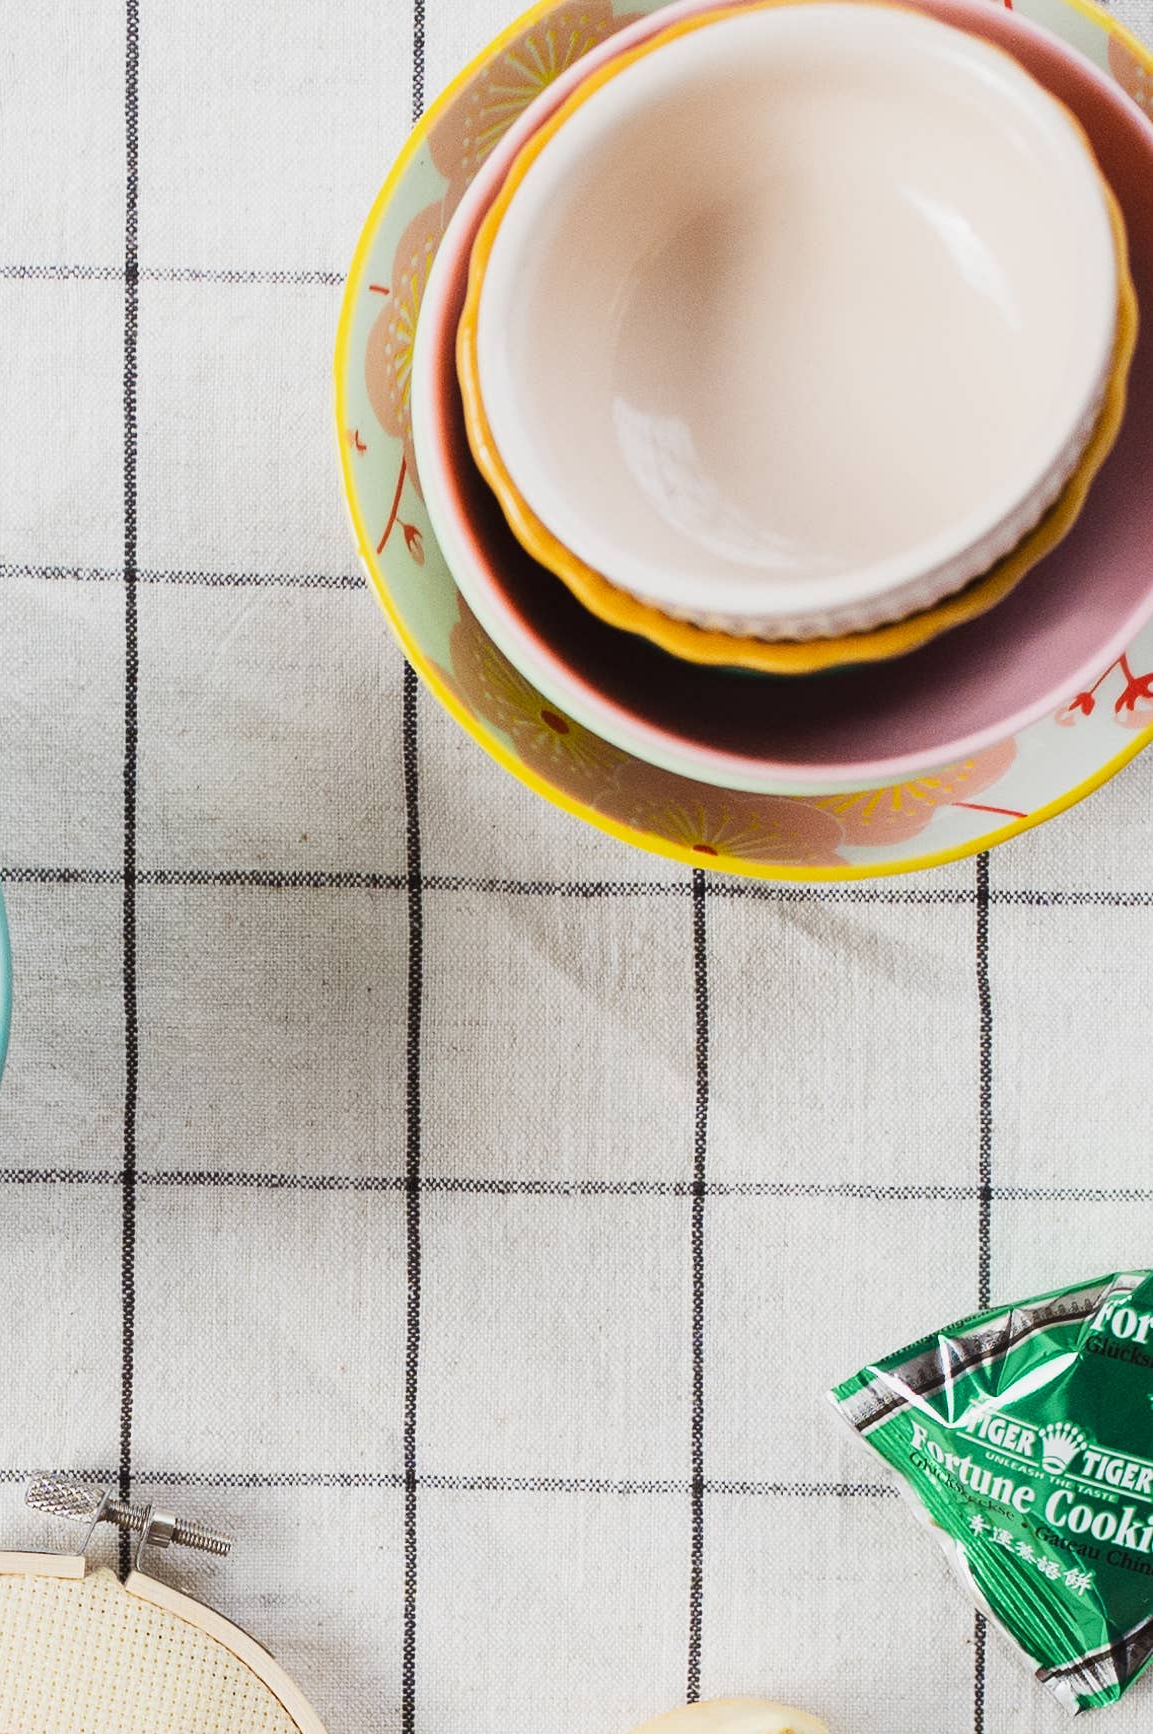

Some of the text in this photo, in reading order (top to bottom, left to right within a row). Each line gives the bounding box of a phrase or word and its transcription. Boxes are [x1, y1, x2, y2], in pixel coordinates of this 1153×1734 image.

[910, 1419, 1153, 1554] Fortune Cooki
[963, 1405, 1153, 1496] TIGER TIGER
[984, 1451, 1118, 1504] UNLEASH THE TASTE
